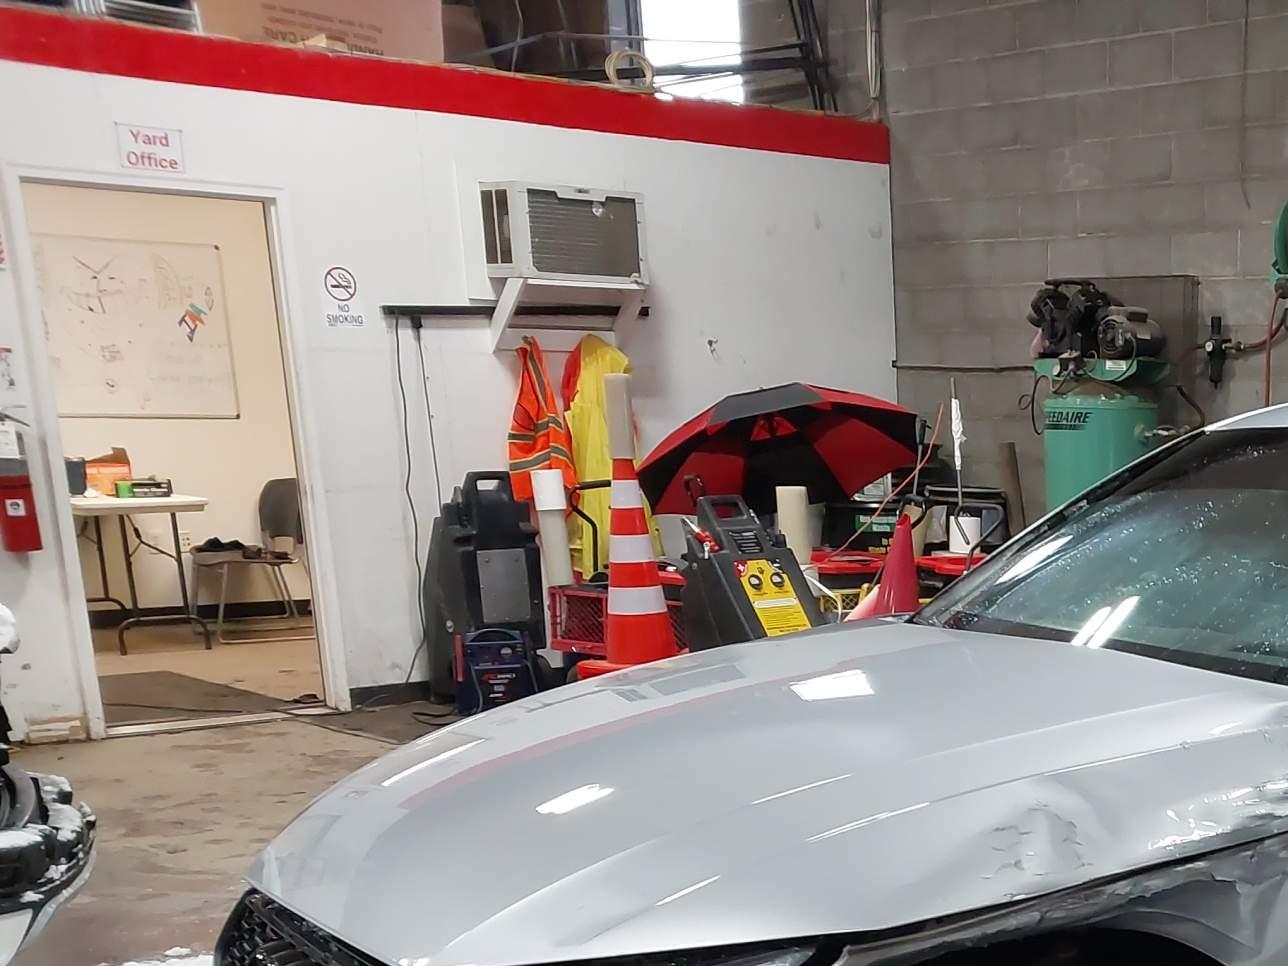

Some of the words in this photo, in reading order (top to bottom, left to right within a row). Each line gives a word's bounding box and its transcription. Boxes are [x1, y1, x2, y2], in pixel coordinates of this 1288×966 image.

[129, 128, 169, 147] Yard
[127, 151, 178, 169] Office
[338, 304, 350, 312] NO
[327, 314, 364, 325] SMOKING
